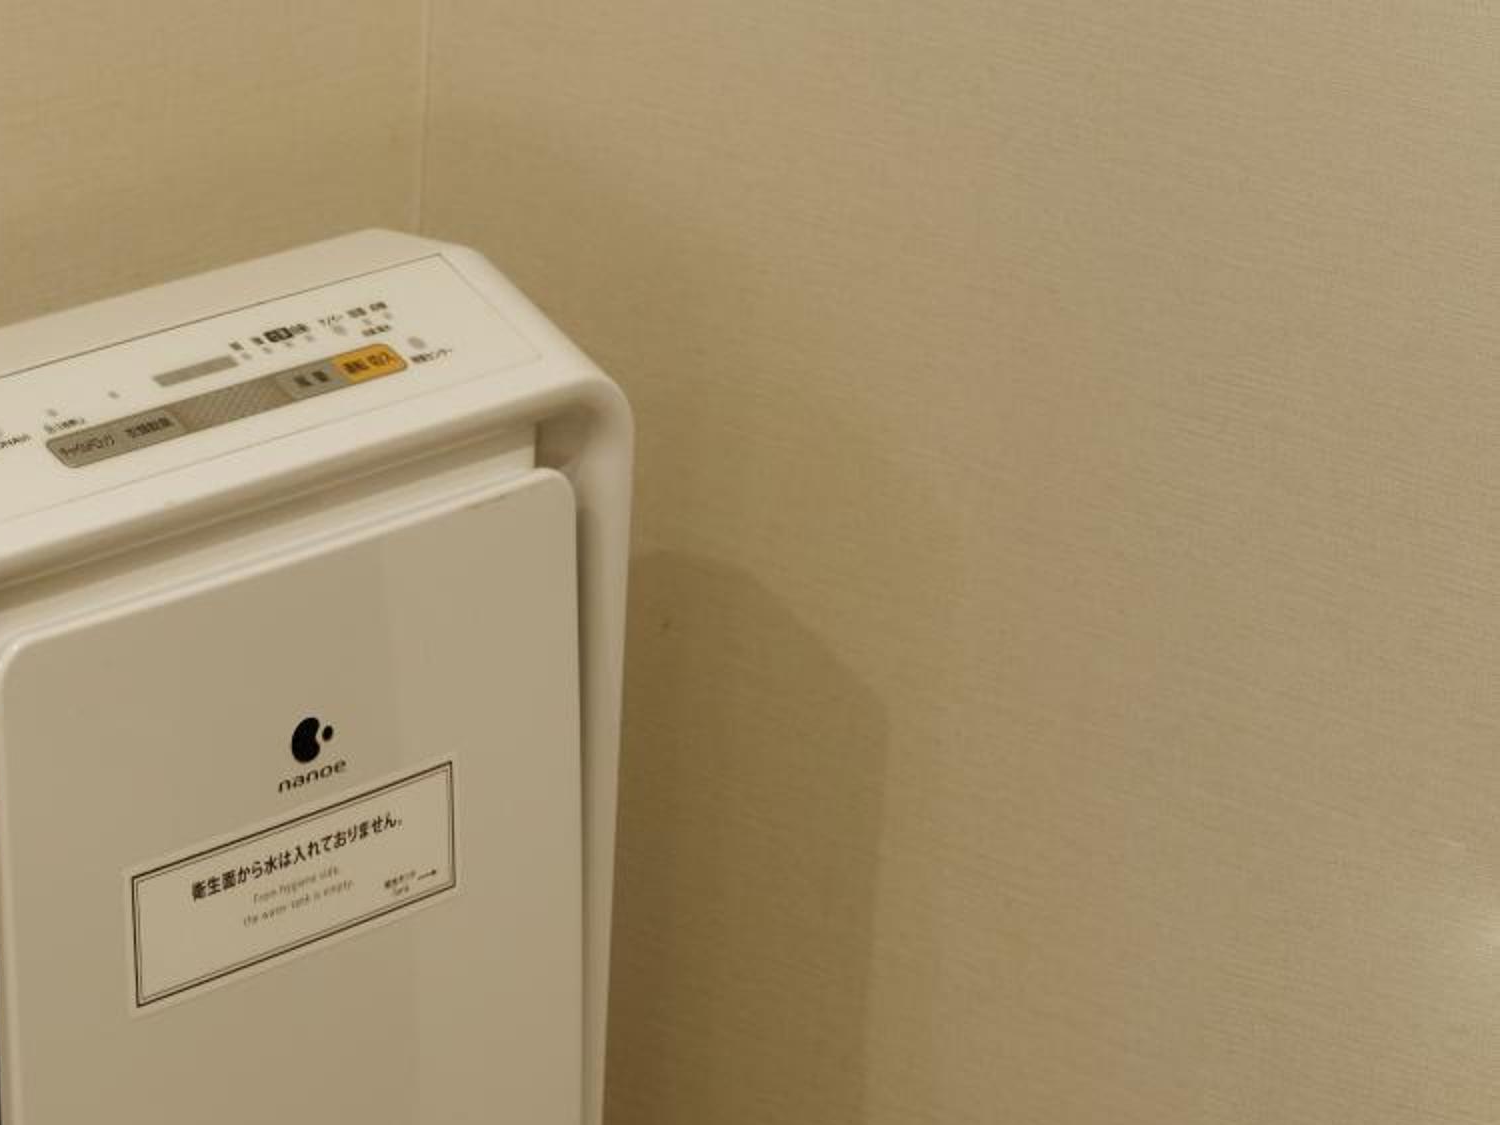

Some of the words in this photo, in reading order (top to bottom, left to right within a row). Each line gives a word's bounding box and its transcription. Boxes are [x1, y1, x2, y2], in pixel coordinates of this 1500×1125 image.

[277, 758, 348, 794] nanoe
[191, 810, 404, 903] 衛生面から水は入れておりません。
